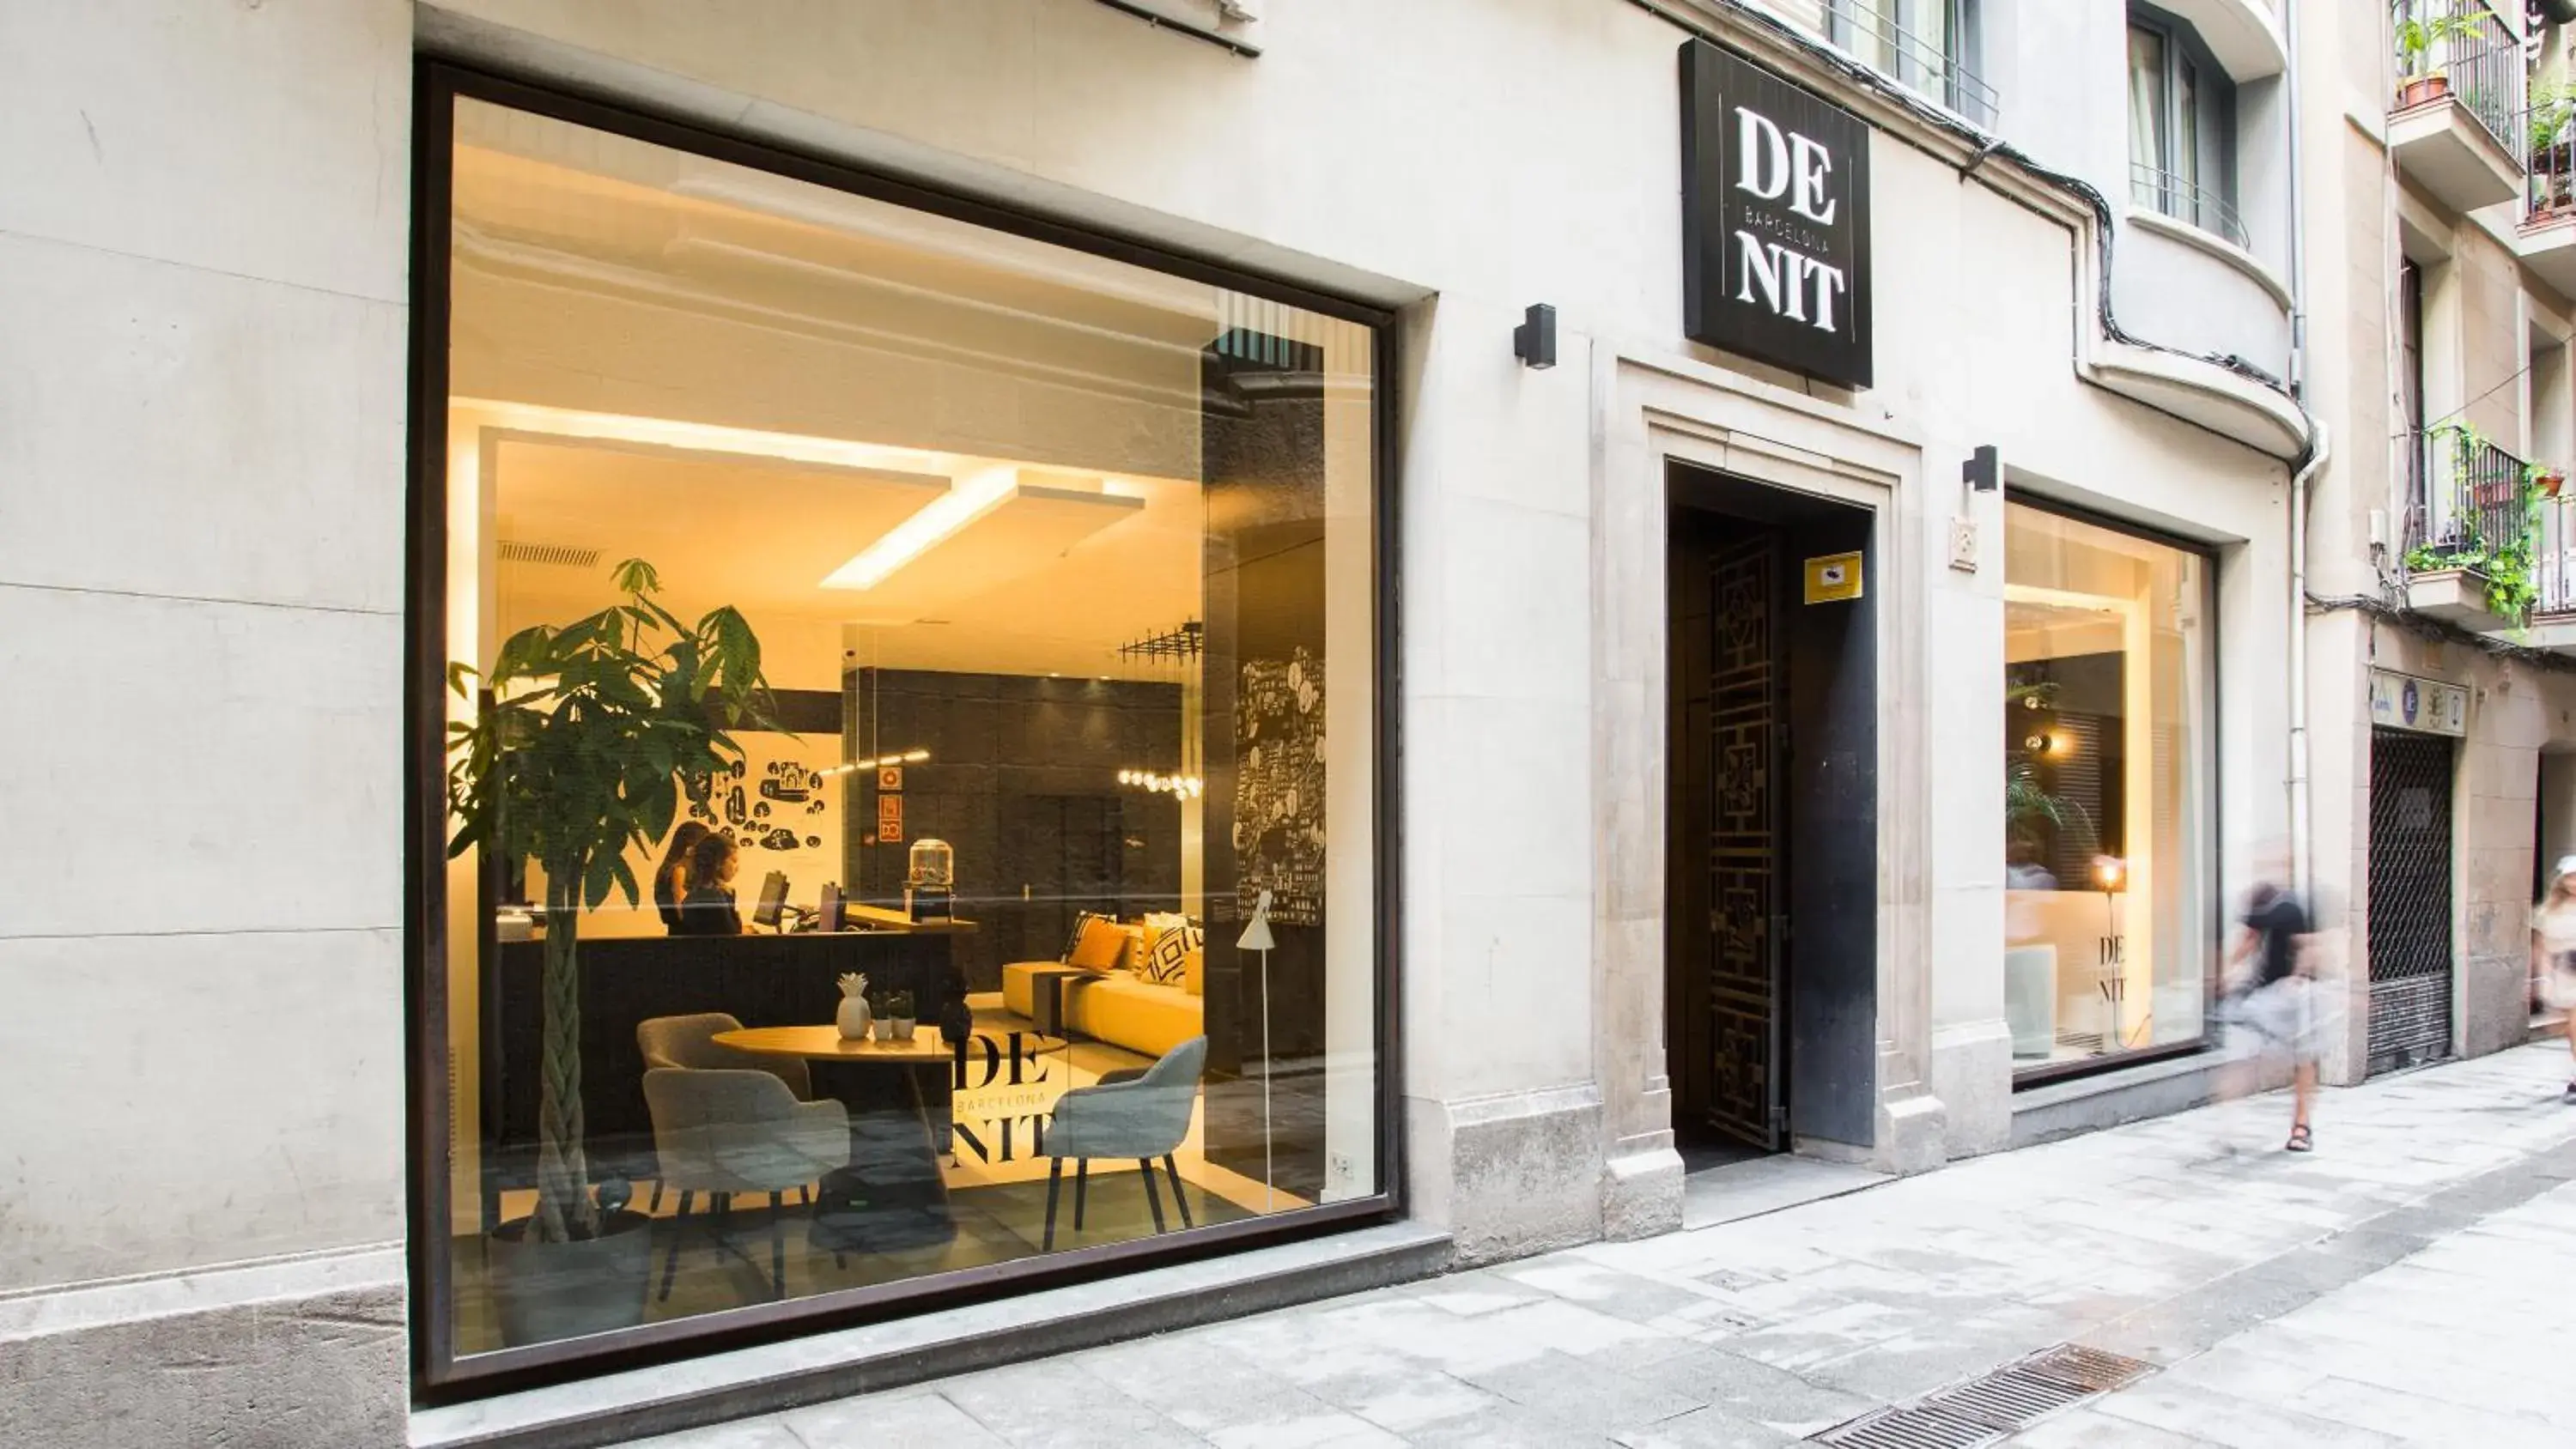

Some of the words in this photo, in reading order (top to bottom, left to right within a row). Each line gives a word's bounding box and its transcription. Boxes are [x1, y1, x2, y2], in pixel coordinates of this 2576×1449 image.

[1734, 105, 1836, 226] DE
[1734, 229, 1845, 333] NIT
[2099, 935, 2125, 966] DE
[2097, 977, 2127, 1005] NIT
[952, 1031, 1048, 1090] DE
[951, 1112, 1058, 1168] NIT
